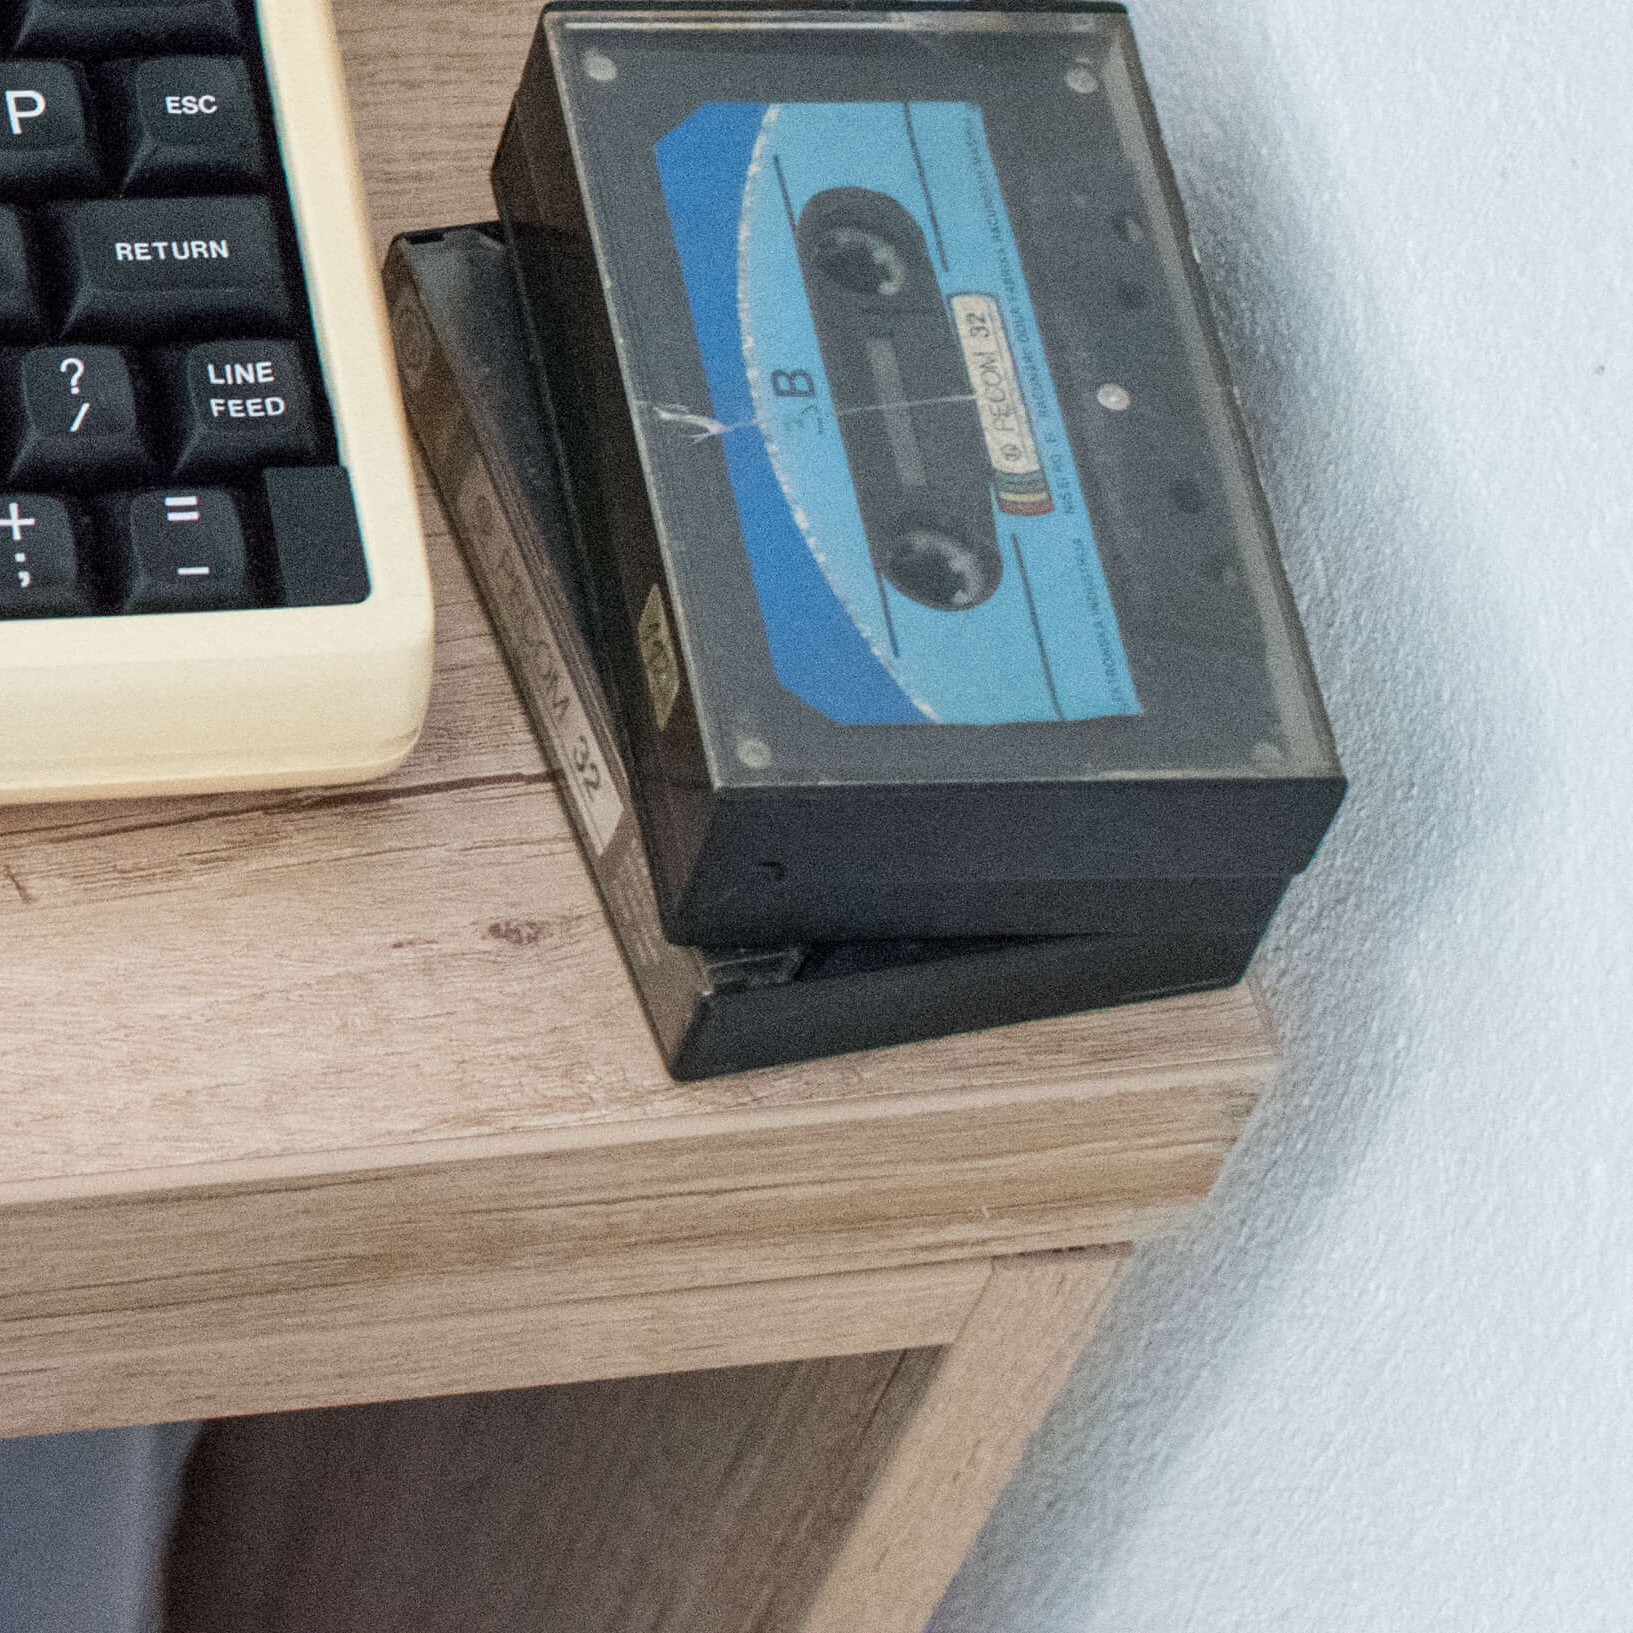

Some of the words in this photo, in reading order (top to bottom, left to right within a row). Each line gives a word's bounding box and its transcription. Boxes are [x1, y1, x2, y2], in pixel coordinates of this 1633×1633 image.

[5, 89, 46, 135] P
[165, 94, 218, 115] ESC
[114, 239, 229, 261] RETURN
[966, 312, 991, 339] 32
[59, 357, 85, 395] ?
[207, 361, 275, 385] LINE
[771, 369, 816, 398] B
[979, 351, 1016, 432] PECOM
[209, 396, 286, 418] FEED
[569, 736, 602, 802] 32
